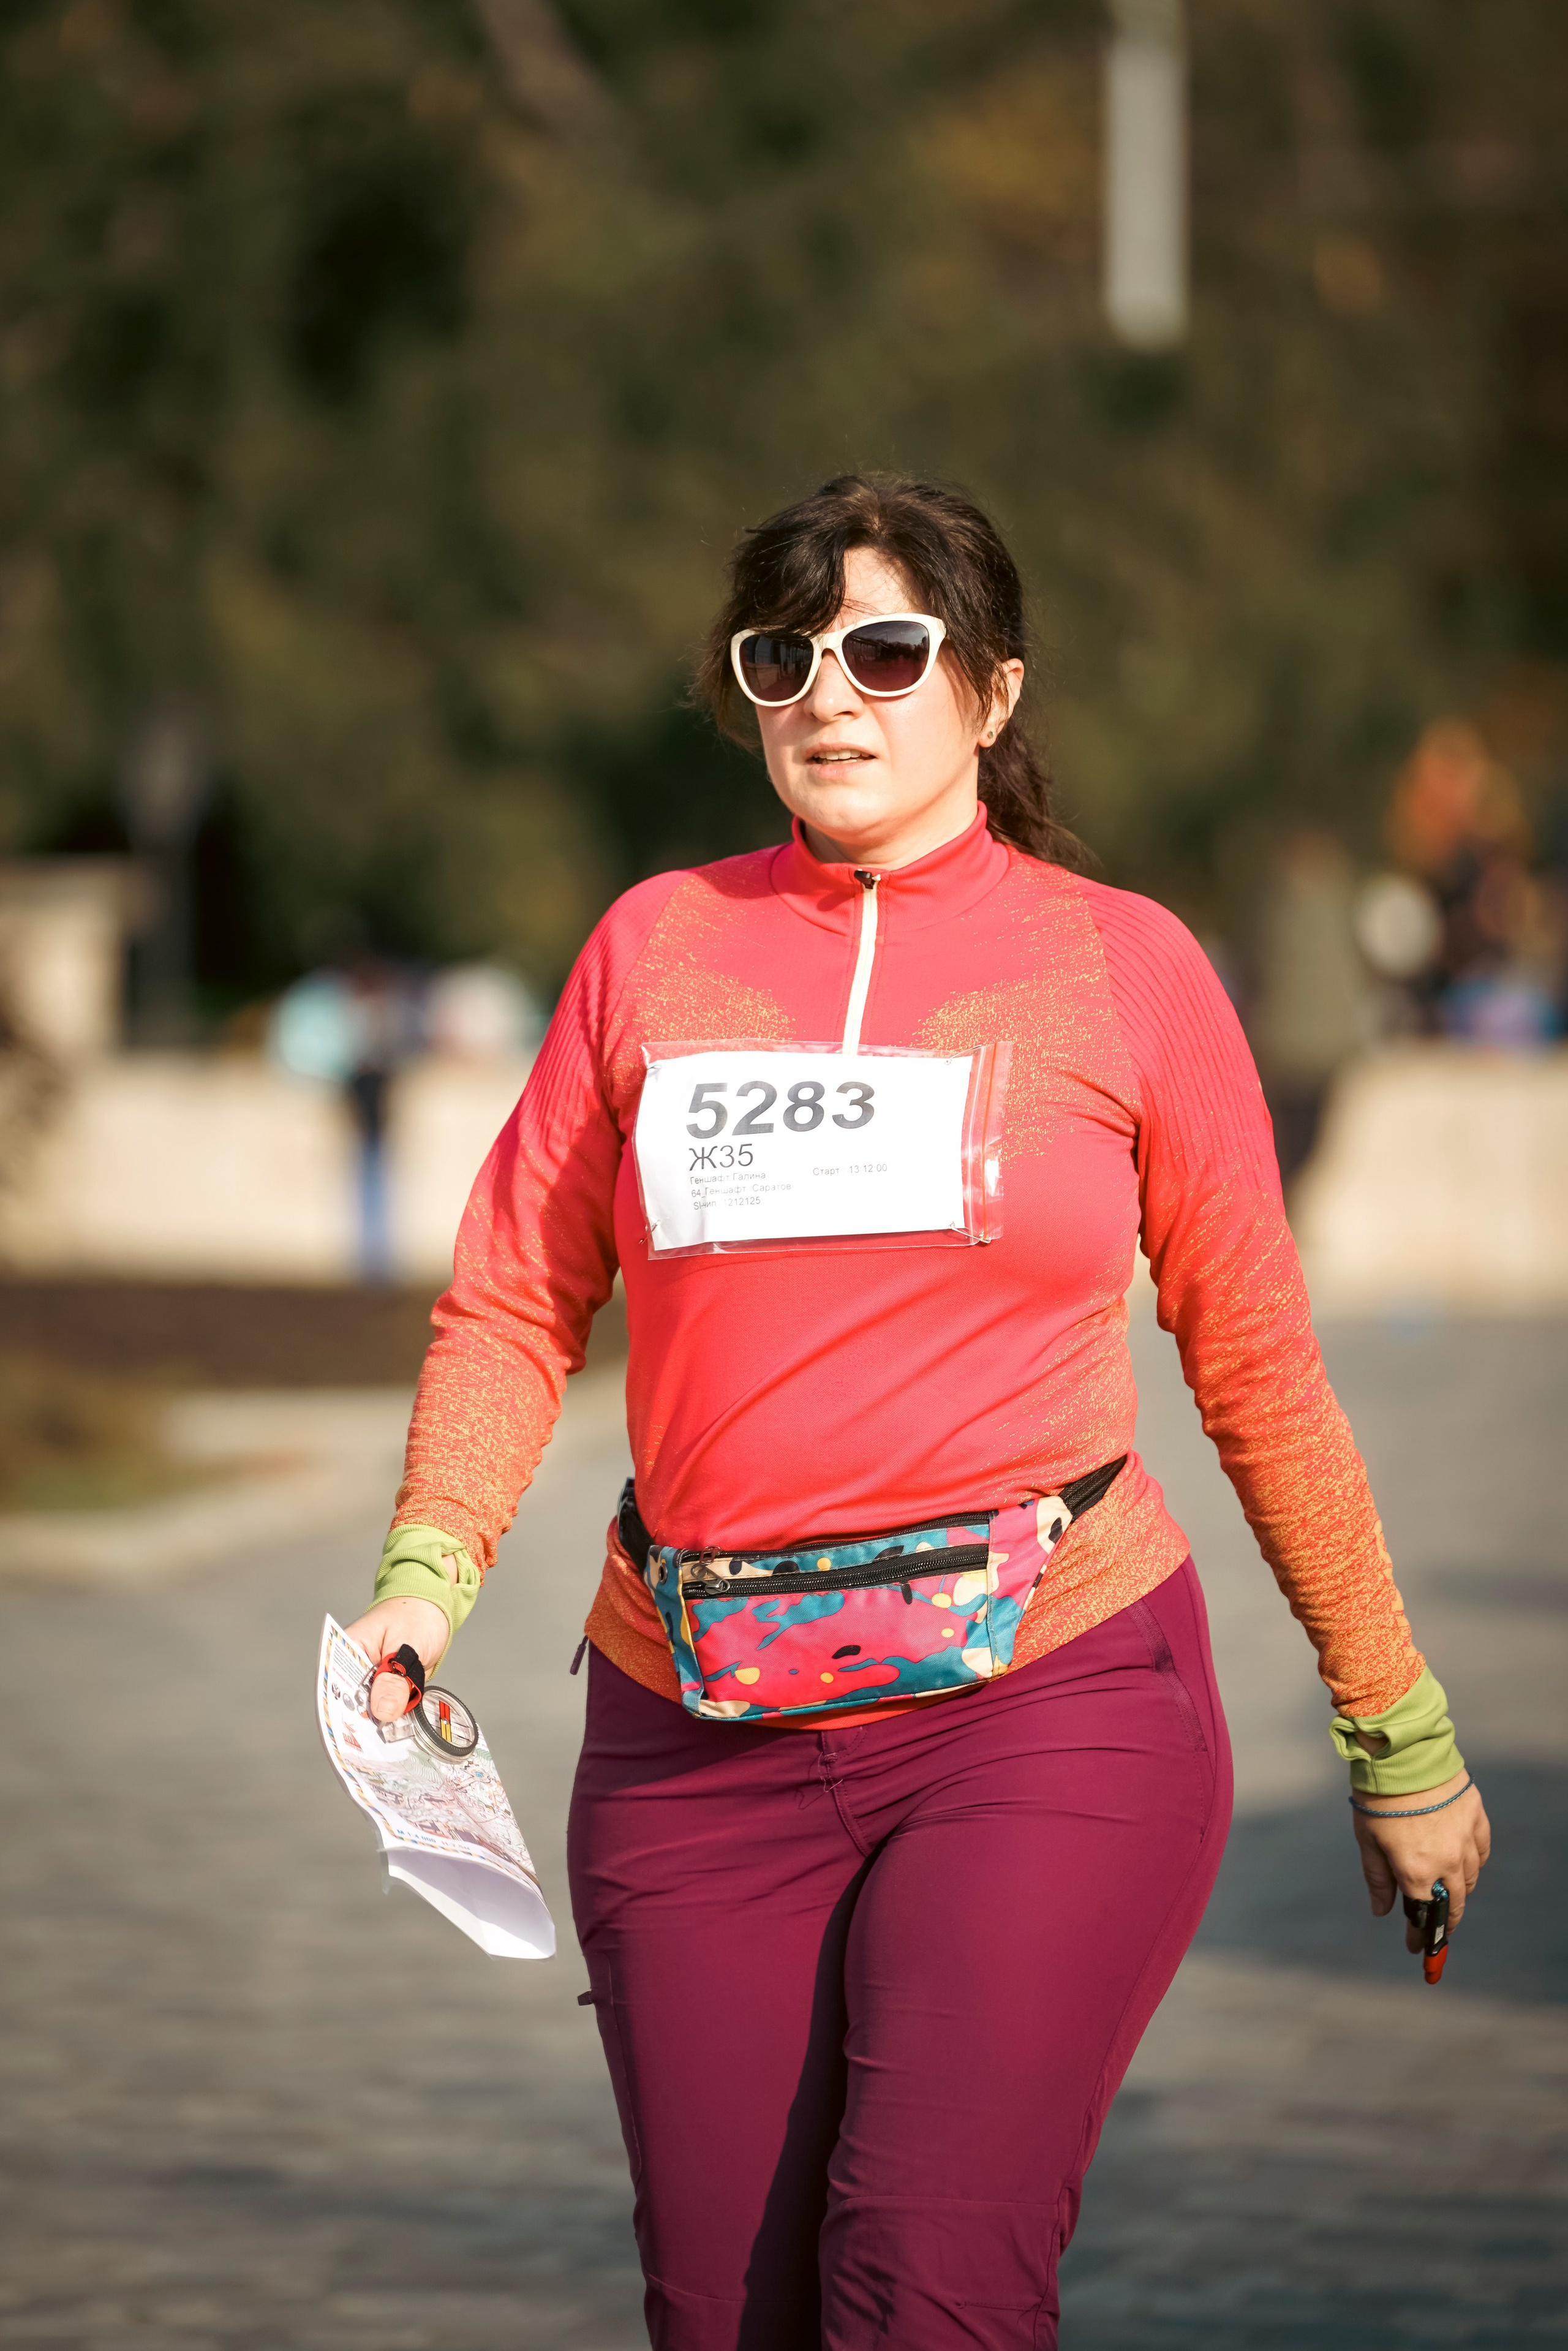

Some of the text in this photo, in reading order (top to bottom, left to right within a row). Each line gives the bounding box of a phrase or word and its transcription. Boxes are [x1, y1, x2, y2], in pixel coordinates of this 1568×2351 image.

[687, 1081, 875, 1139] 5283
[688, 1143, 753, 1171] Ж35
[812, 1168, 840, 1176] Старт
[690, 1174, 729, 1185] Геншафт
[752, 1183, 791, 1193] Саратов
[723, 1196, 761, 1207] 1212125
